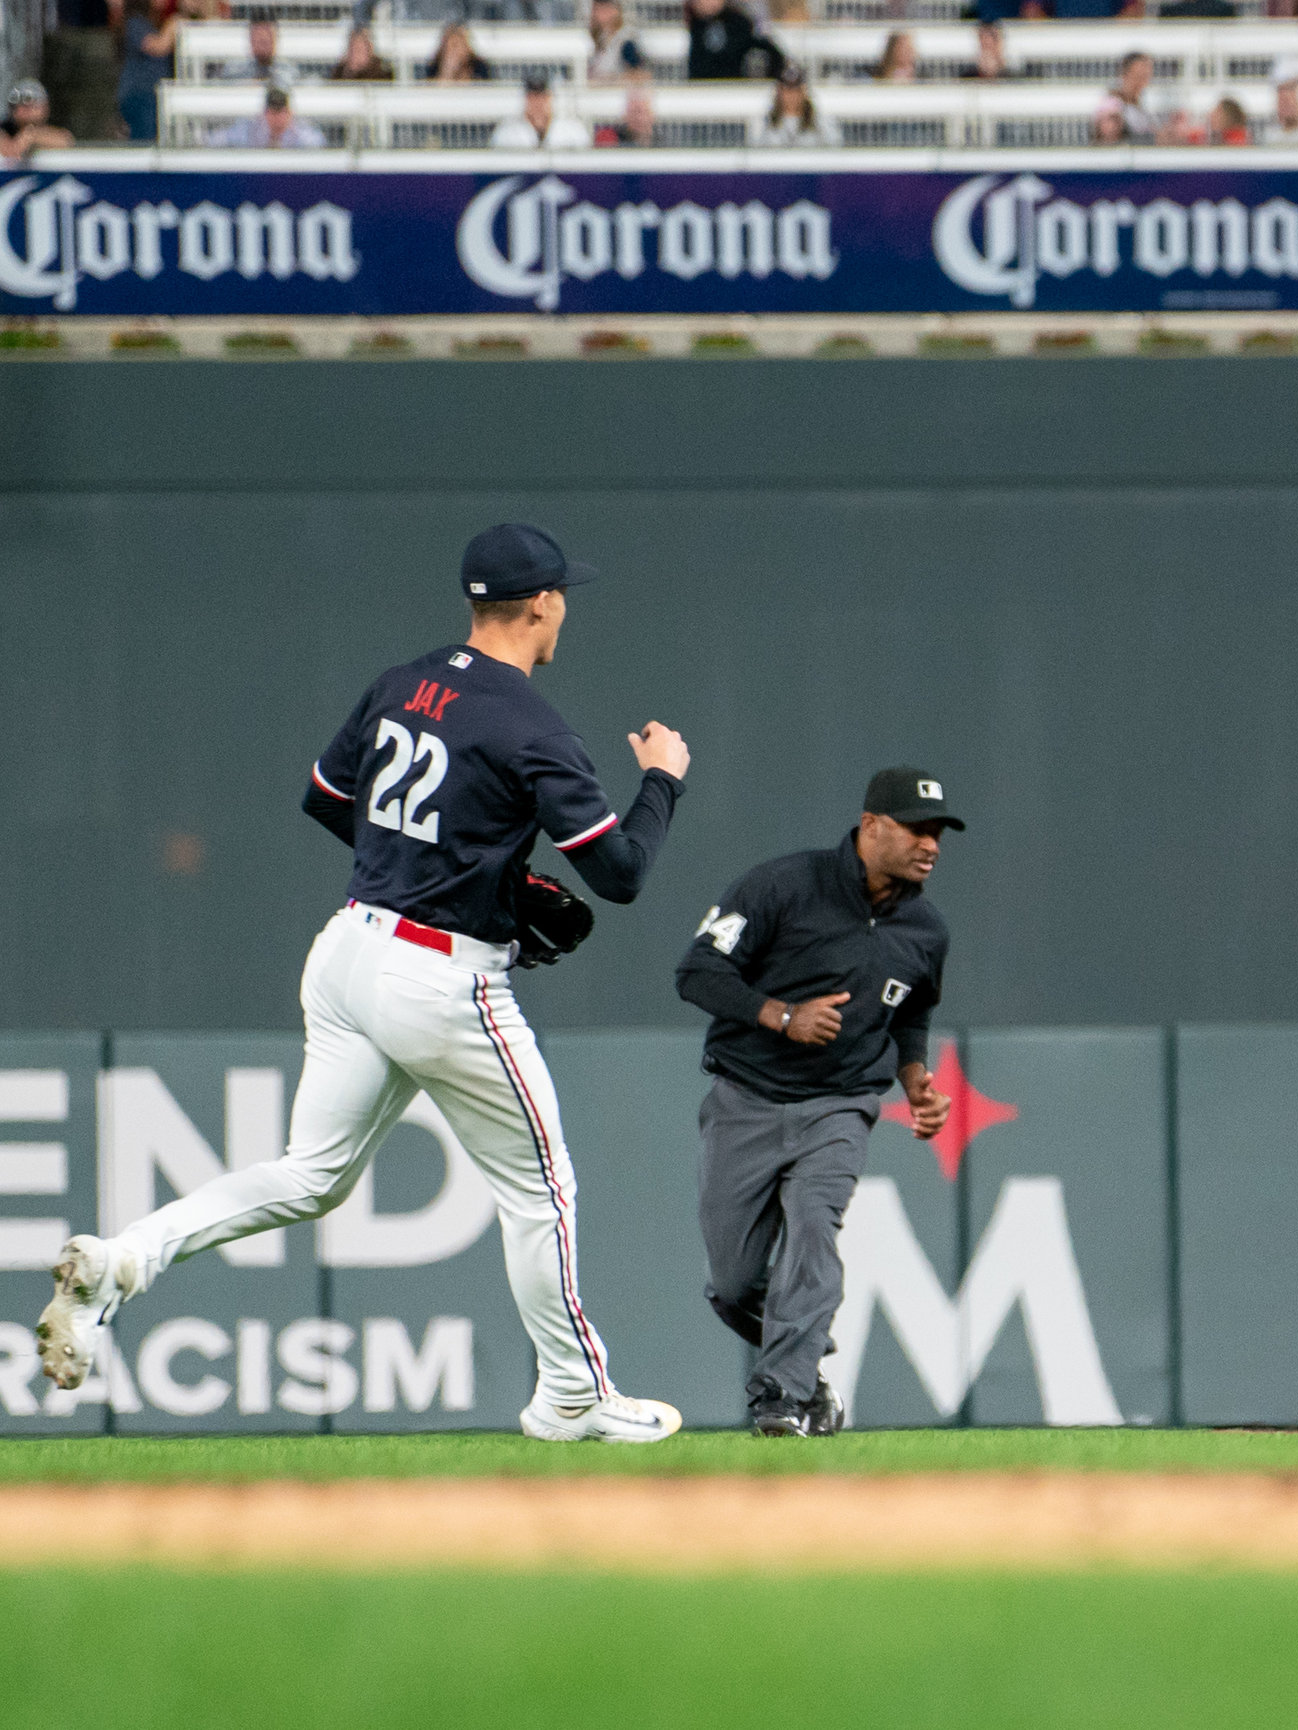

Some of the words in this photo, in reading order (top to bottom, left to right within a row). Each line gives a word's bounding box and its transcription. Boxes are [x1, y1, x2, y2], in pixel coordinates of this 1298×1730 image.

[0, 173, 362, 311] Corona
[456, 173, 841, 311] Corona
[403, 679, 460, 722] JAX
[368, 717, 449, 844] 22
